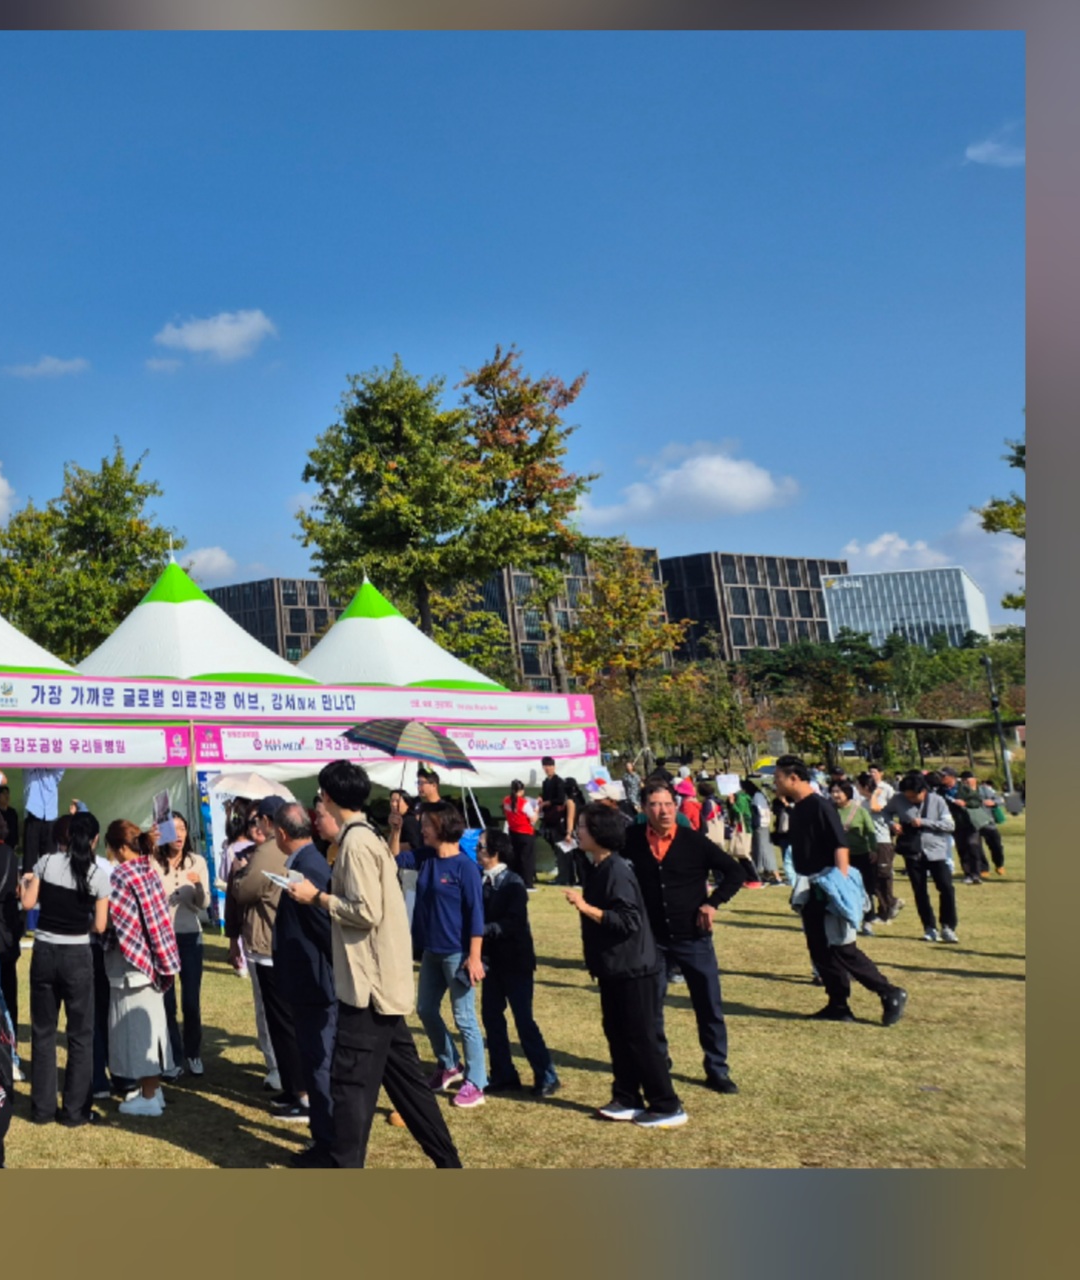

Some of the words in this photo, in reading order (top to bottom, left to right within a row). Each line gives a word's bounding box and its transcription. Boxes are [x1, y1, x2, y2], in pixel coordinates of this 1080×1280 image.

[31, 684, 62, 706] 가장
[70, 685, 115, 707] 가까운
[123, 688, 165, 709] 글로벌
[171, 689, 226, 710] 의료관광
[233, 692, 265, 712] 허브,
[321, 694, 356, 711] 만나다
[69, 738, 126, 754] 우리들병원
